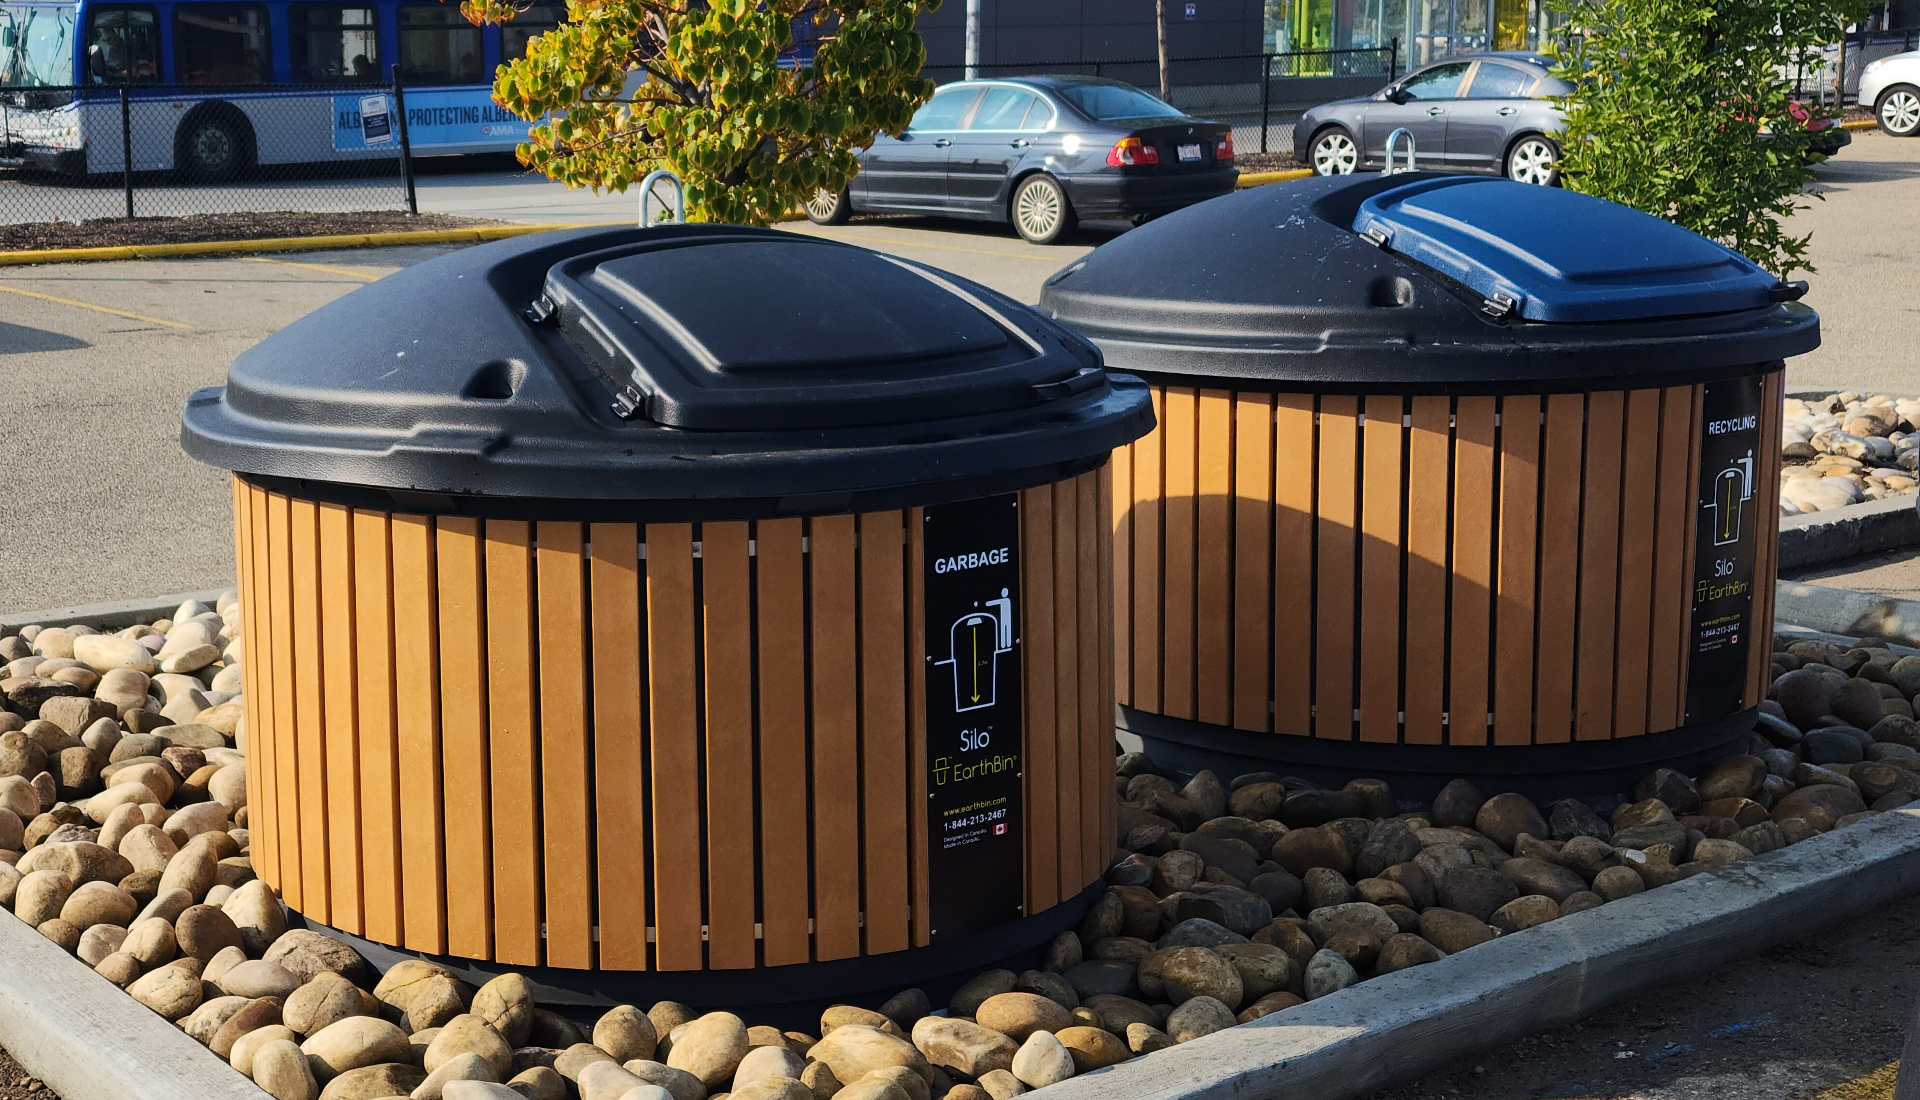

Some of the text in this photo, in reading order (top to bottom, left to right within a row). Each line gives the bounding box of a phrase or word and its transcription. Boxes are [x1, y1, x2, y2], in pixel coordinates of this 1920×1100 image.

[408, 105, 479, 127] PROTECTING
[489, 125, 515, 136] AMA
[1708, 415, 1756, 435] RECYCLING
[934, 547, 1009, 574] GARBAGE
[960, 727, 990, 752] Silo
[943, 796, 1007, 817] www.earthbin.com
[943, 808, 1007, 831] 1-844-213-2467
